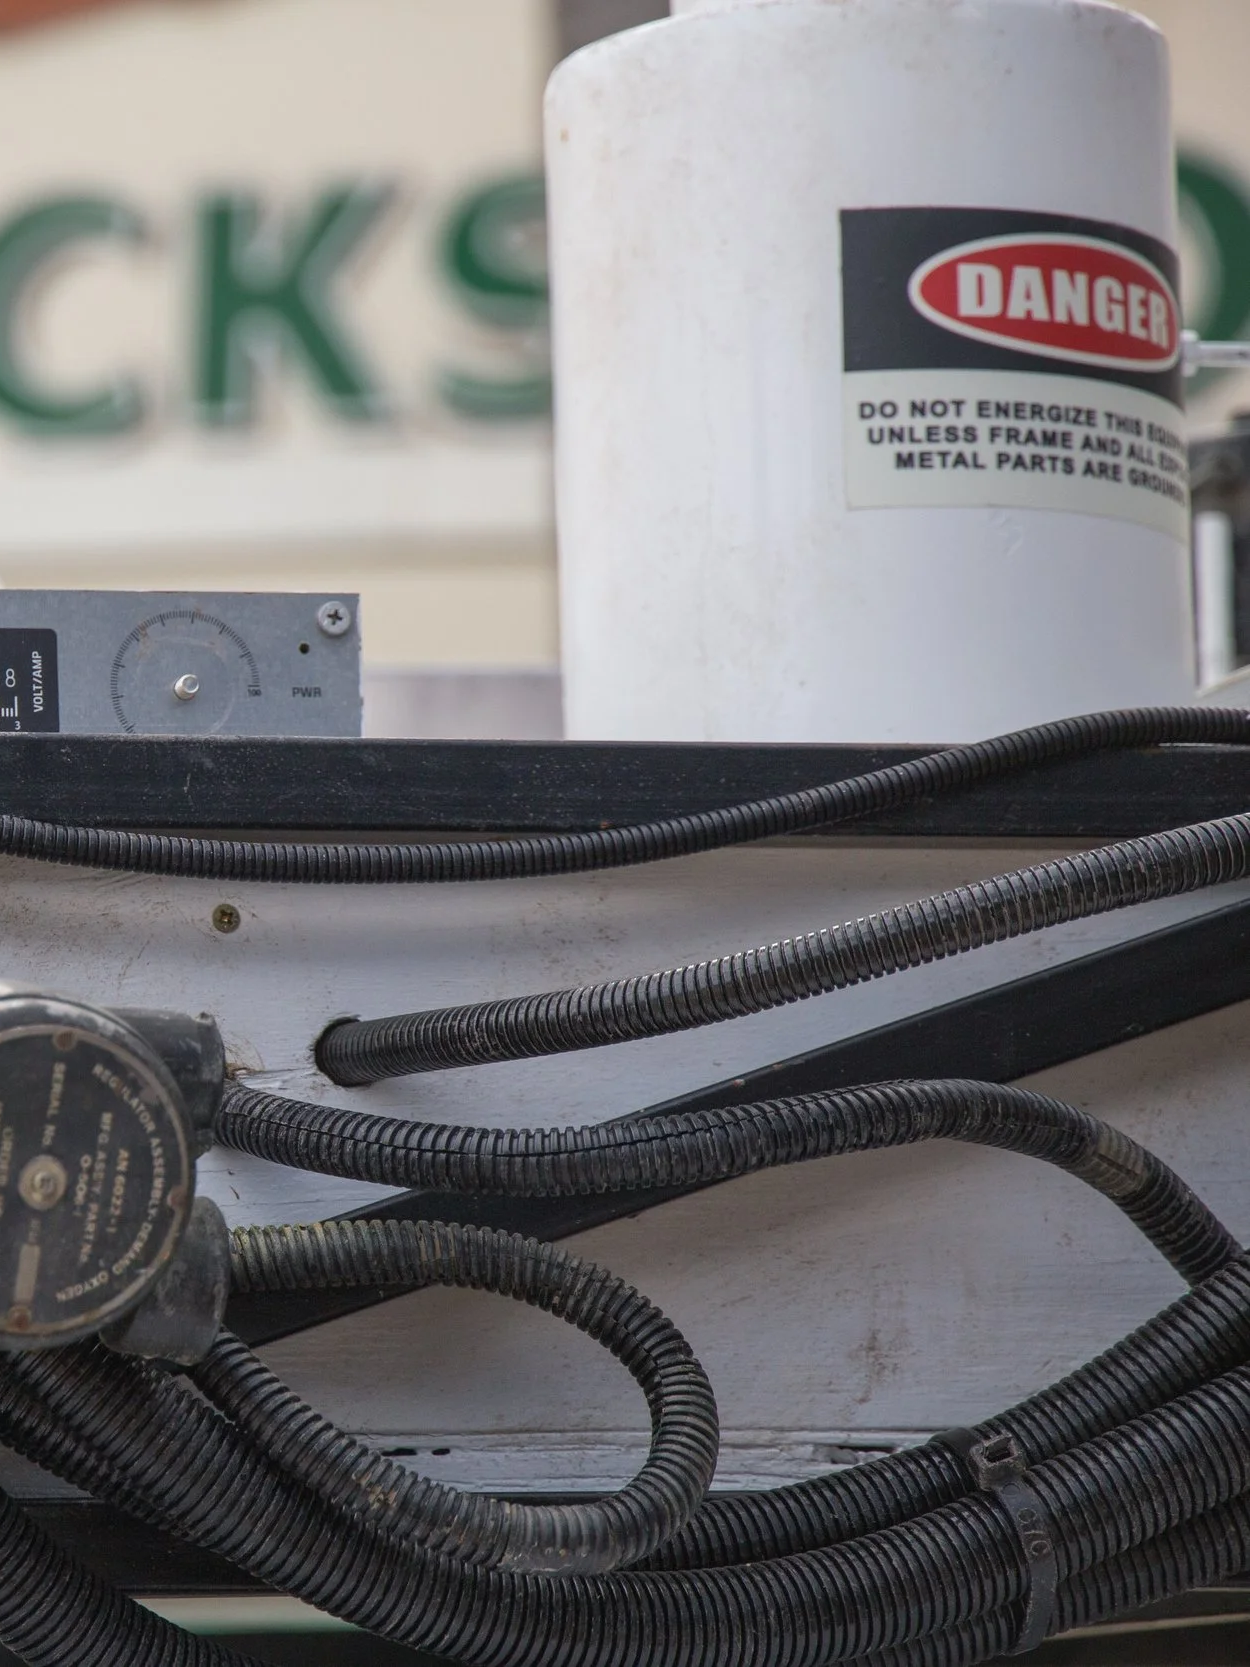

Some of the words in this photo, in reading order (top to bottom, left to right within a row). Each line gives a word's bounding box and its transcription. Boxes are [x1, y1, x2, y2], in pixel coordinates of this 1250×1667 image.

[956, 262, 1169, 350] DANGER
[858, 401, 898, 419] DO
[910, 400, 966, 419] NOT
[977, 401, 1097, 427] ENERGIZE
[1104, 412, 1142, 438] THIS
[867, 426, 978, 445] UNLESS
[989, 427, 1074, 449] FRAME
[1081, 435, 1121, 457] AND
[1127, 444, 1155, 467] ALL
[895, 452, 986, 470] METAL
[996, 453, 1075, 476] PARTS
[1081, 461, 1123, 484] ARE
[31, 650, 44, 713] VOLT/AMP
[291, 686, 322, 698] PWR
[14, 721, 21, 730] 3
[46, 1061, 66, 1118] SERIAL
